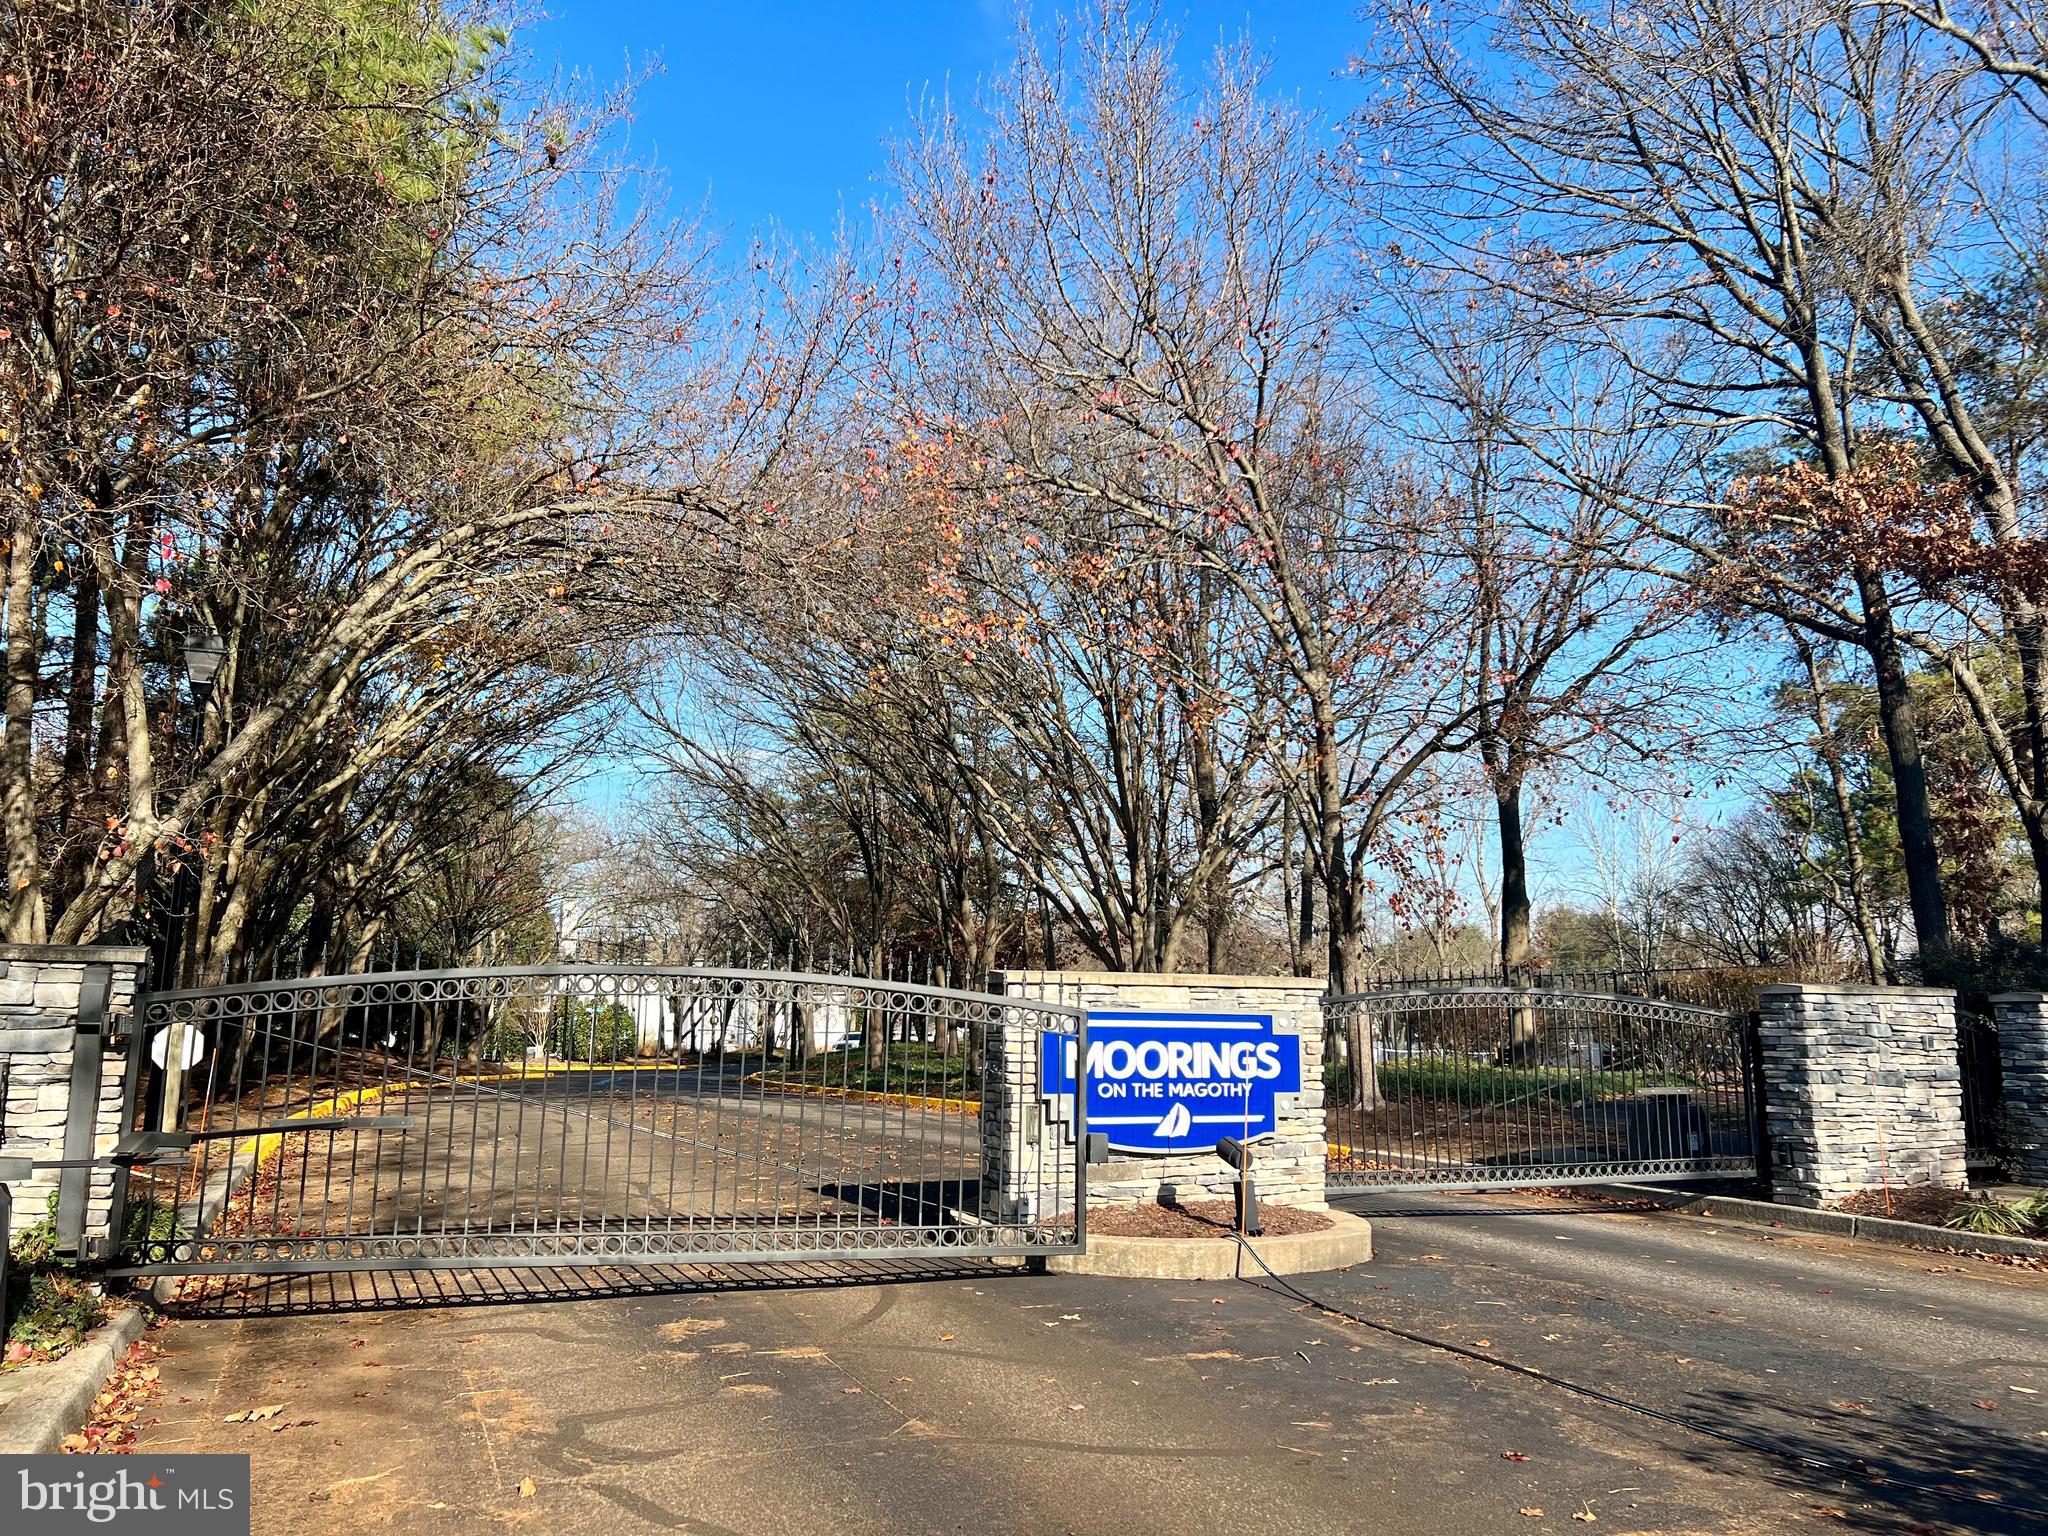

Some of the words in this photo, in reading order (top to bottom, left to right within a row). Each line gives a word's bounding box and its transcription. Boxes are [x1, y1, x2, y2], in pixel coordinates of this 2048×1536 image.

[1066, 1041, 1281, 1079] MOORINGS
[1097, 1082, 1127, 1098] ON
[1131, 1082, 1163, 1098] THE
[1168, 1082, 1253, 1098] MAGOTHY
